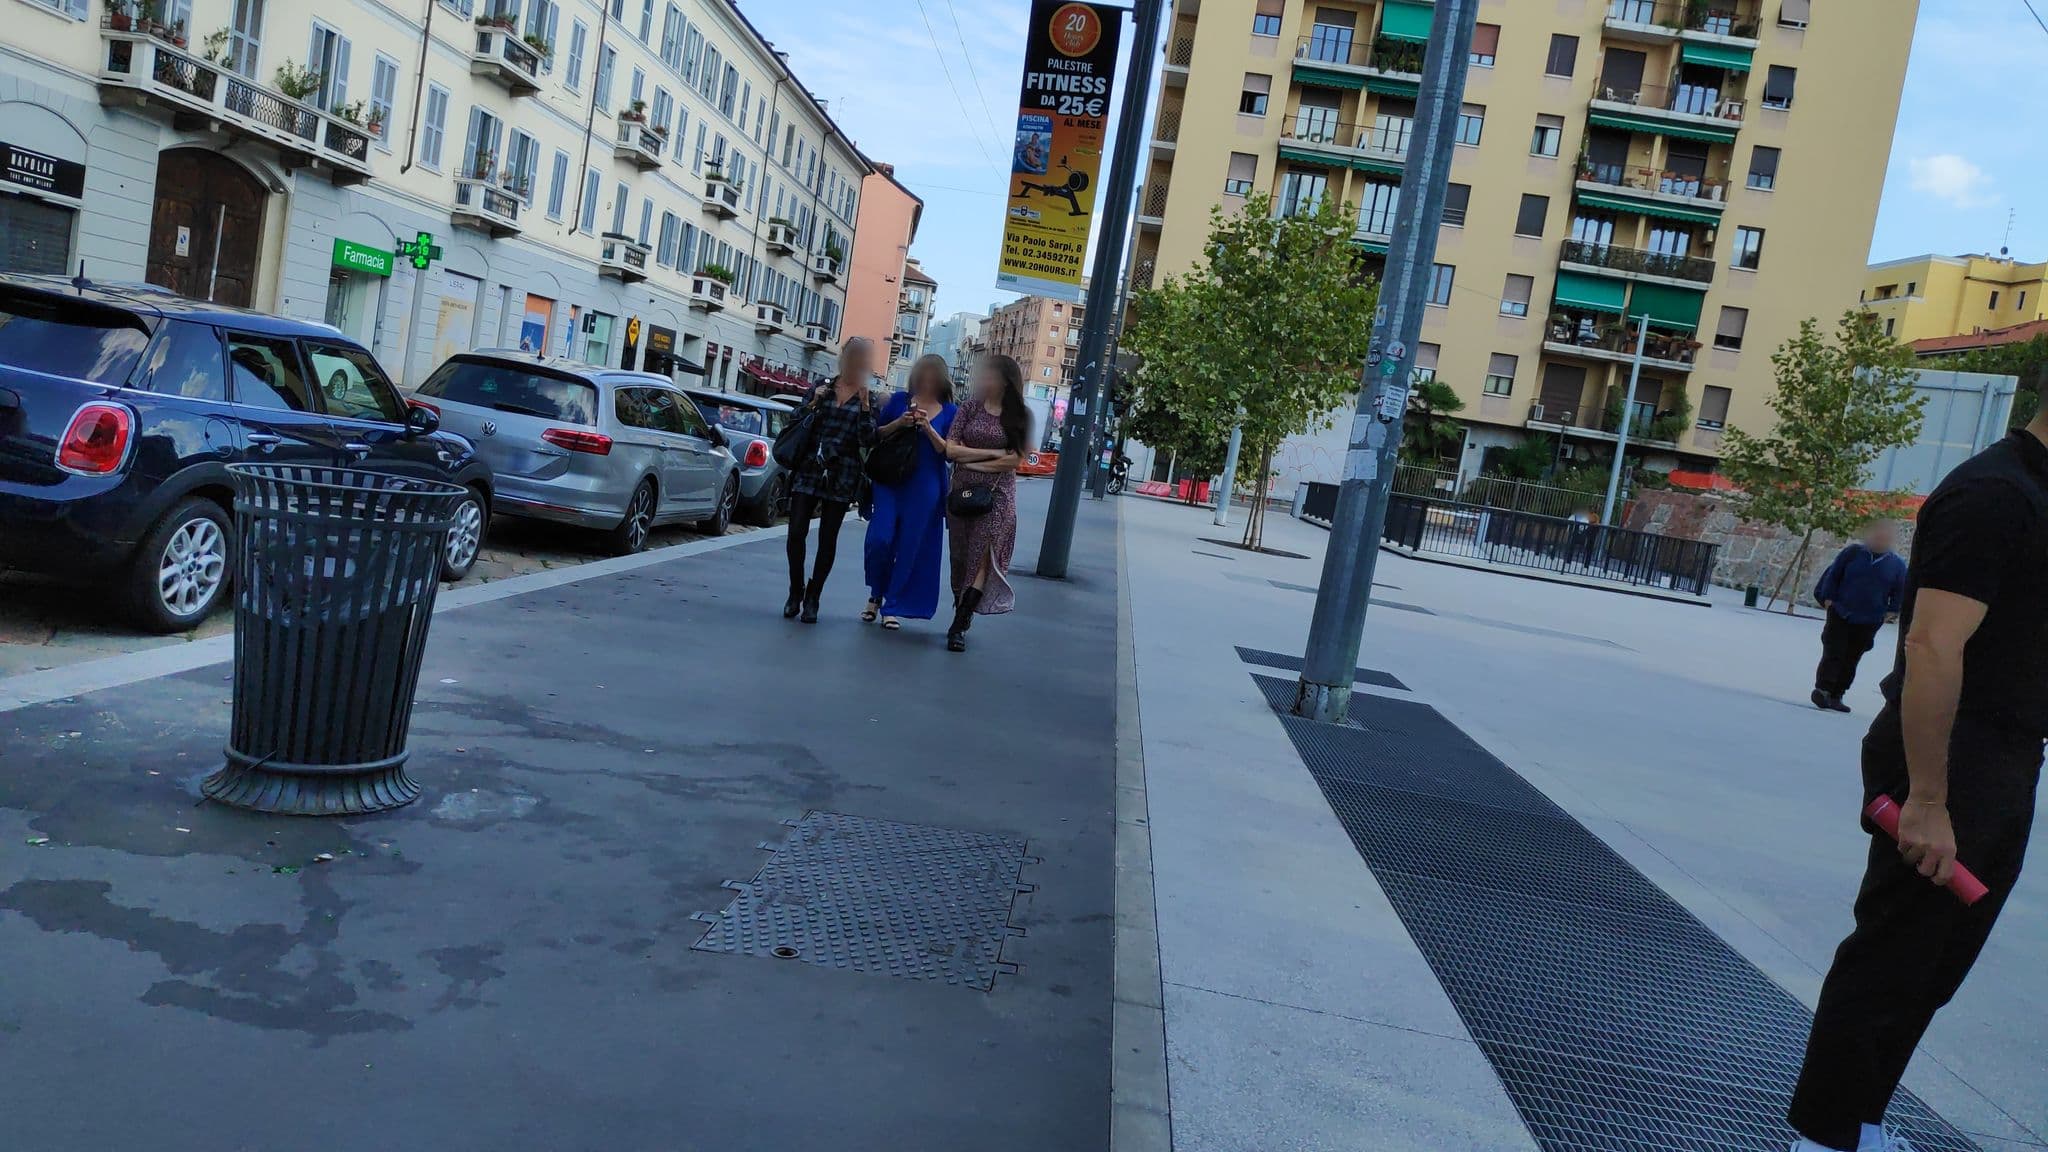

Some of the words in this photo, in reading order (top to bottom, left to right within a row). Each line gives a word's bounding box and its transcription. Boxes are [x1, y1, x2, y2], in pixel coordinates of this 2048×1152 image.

[1065, 13, 1086, 31] 20
[1047, 58, 1094, 73] PALESTRE
[1026, 72, 1106, 95] FITNESS
[1040, 95, 1056, 106] DA
[1057, 95, 1104, 117] 25€
[1022, 114, 1049, 123] PISCINA
[1063, 118, 1074, 127] AL
[1077, 119, 1101, 129] MESE
[1007, 232, 1020, 243] Via
[1022, 235, 1047, 247] Paolo
[1048, 239, 1074, 253] Sarpi,
[1076, 244, 1082, 253] 8
[343, 246, 385, 270] Farmacia
[1006, 244, 1020, 255] Tel.
[1022, 248, 1079, 265] 02.34592784
[1004, 258, 1077, 277] WWW.20HOURS.IT
